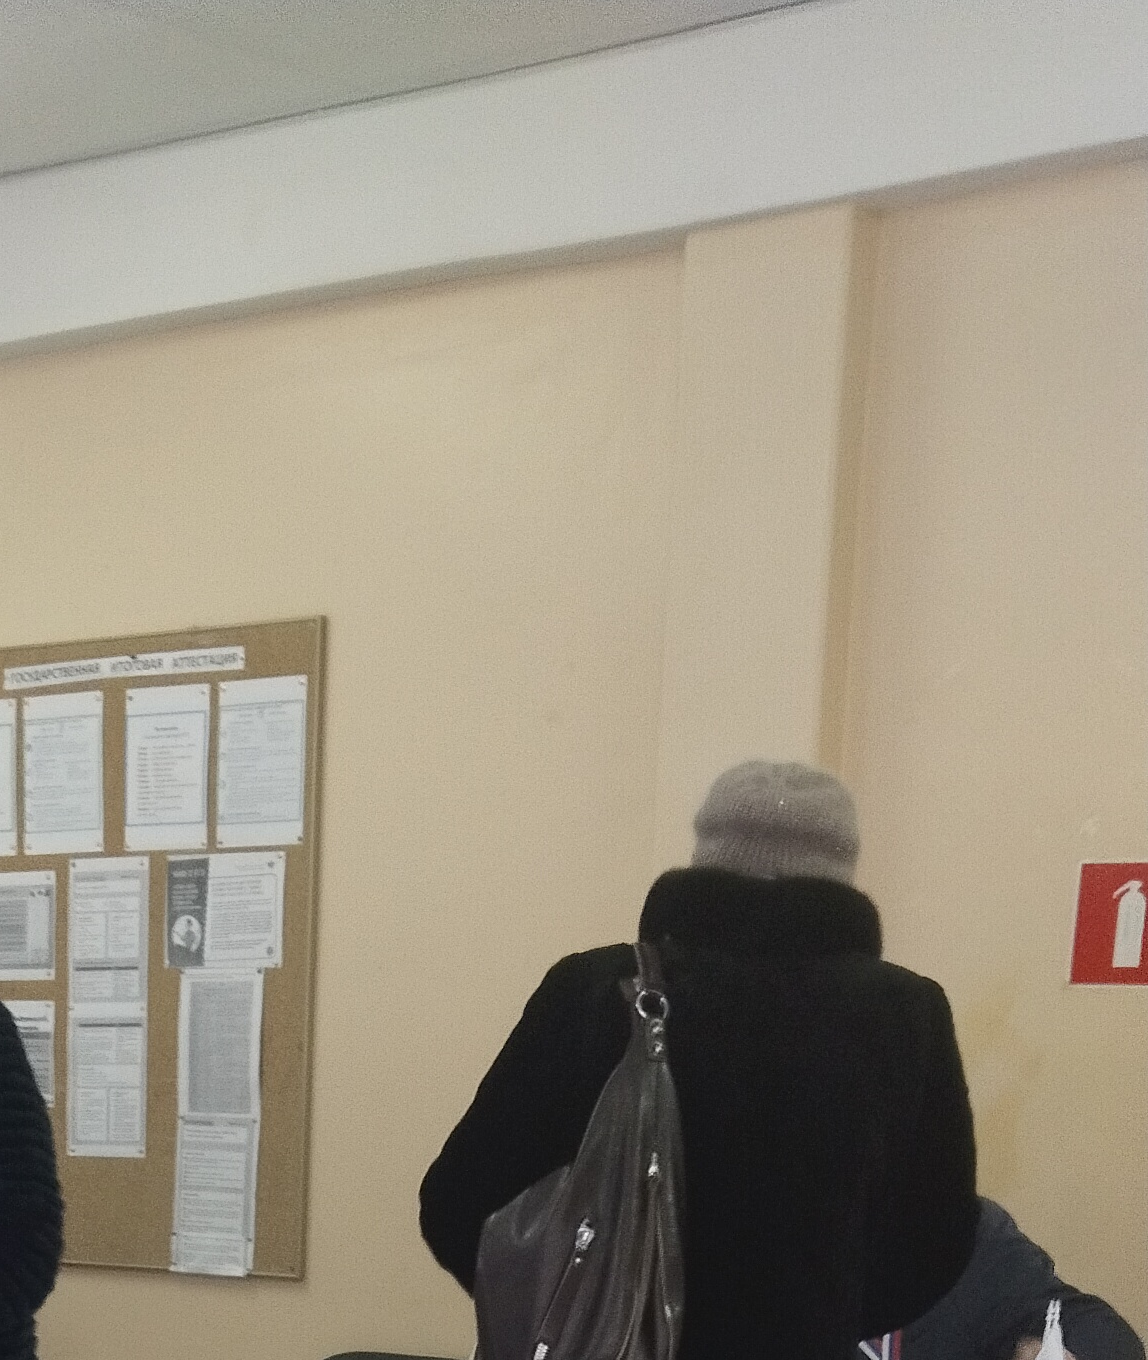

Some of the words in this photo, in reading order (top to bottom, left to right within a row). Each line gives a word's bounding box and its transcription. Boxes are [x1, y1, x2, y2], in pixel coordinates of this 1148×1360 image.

[9, 661, 101, 685] ГОСУДАРСТВЕННАЯ
[110, 657, 164, 674] ИТОГОВАЯ
[172, 651, 239, 669] АТТЕСТАЦИЯ
